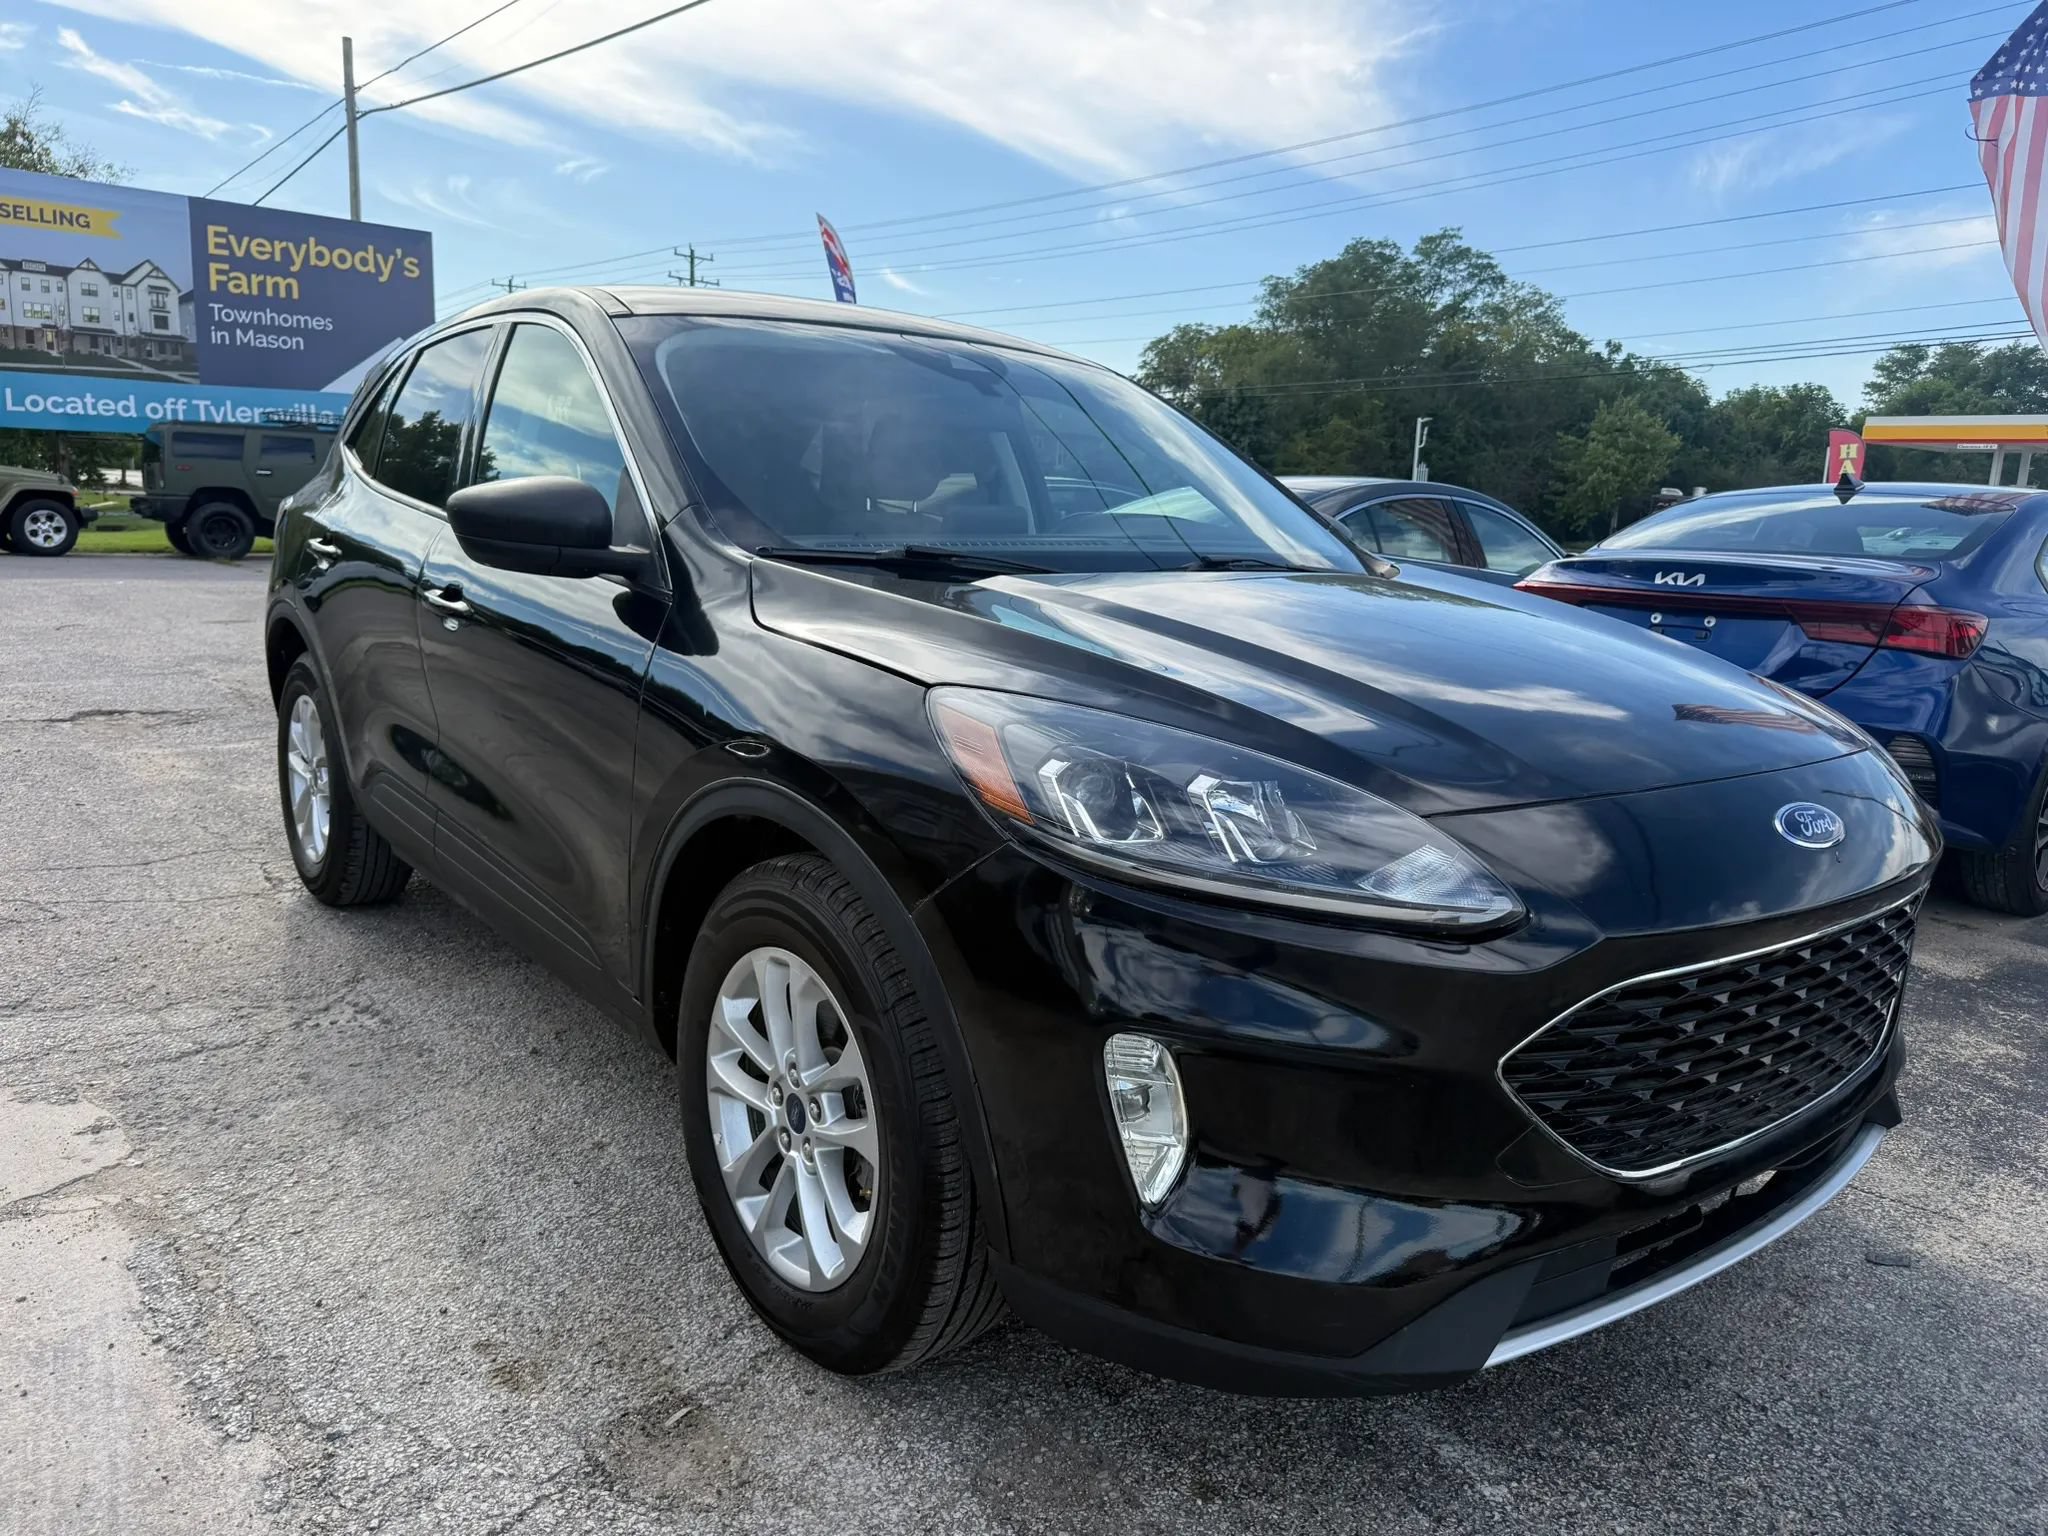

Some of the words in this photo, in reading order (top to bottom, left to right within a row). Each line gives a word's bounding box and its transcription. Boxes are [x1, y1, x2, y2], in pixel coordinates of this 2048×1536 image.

[0, 202, 90, 229] SELLING
[206, 224, 421, 283] Everybody's
[208, 261, 300, 300] Farm
[208, 302, 334, 331] Townhomes
[210, 325, 230, 345] in
[236, 327, 305, 350] Mason
[4, 387, 138, 418] Located
[145, 397, 188, 421] off
[1794, 810, 1836, 837] Ford
